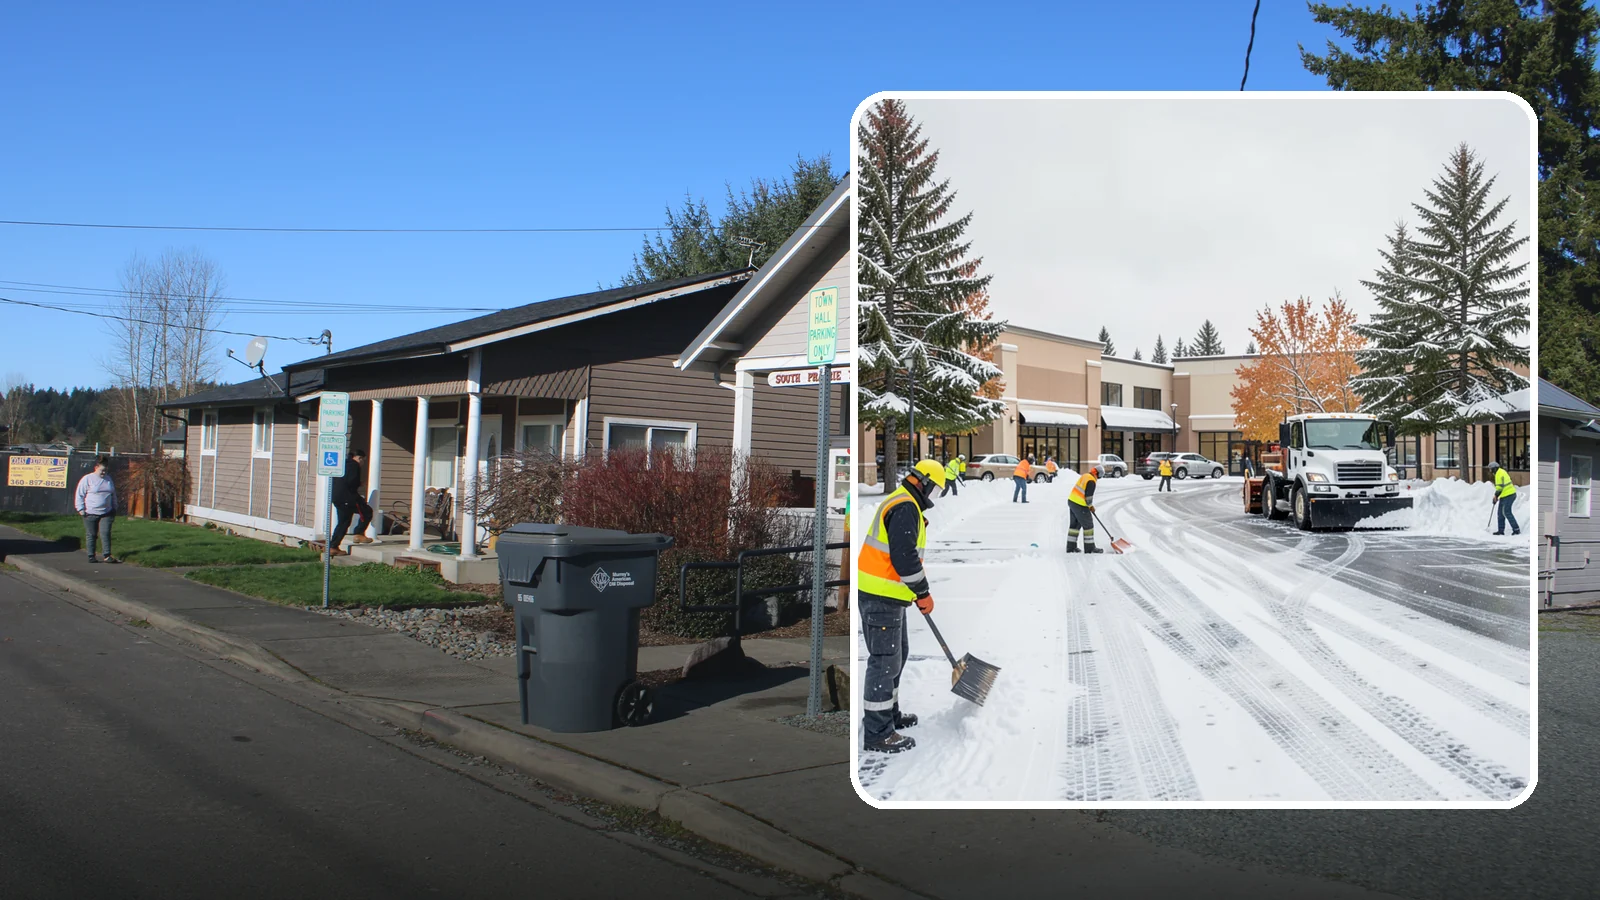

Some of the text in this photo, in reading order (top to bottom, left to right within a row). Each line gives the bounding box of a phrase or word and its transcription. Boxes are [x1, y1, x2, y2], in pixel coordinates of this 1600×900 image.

[815, 295, 833, 308] TOWN
[814, 312, 831, 324] HALL
[810, 326, 835, 341] PARKING
[813, 344, 831, 357] ONLY
[775, 374, 801, 384] SOUTH
[807, 371, 842, 382] PRIE
